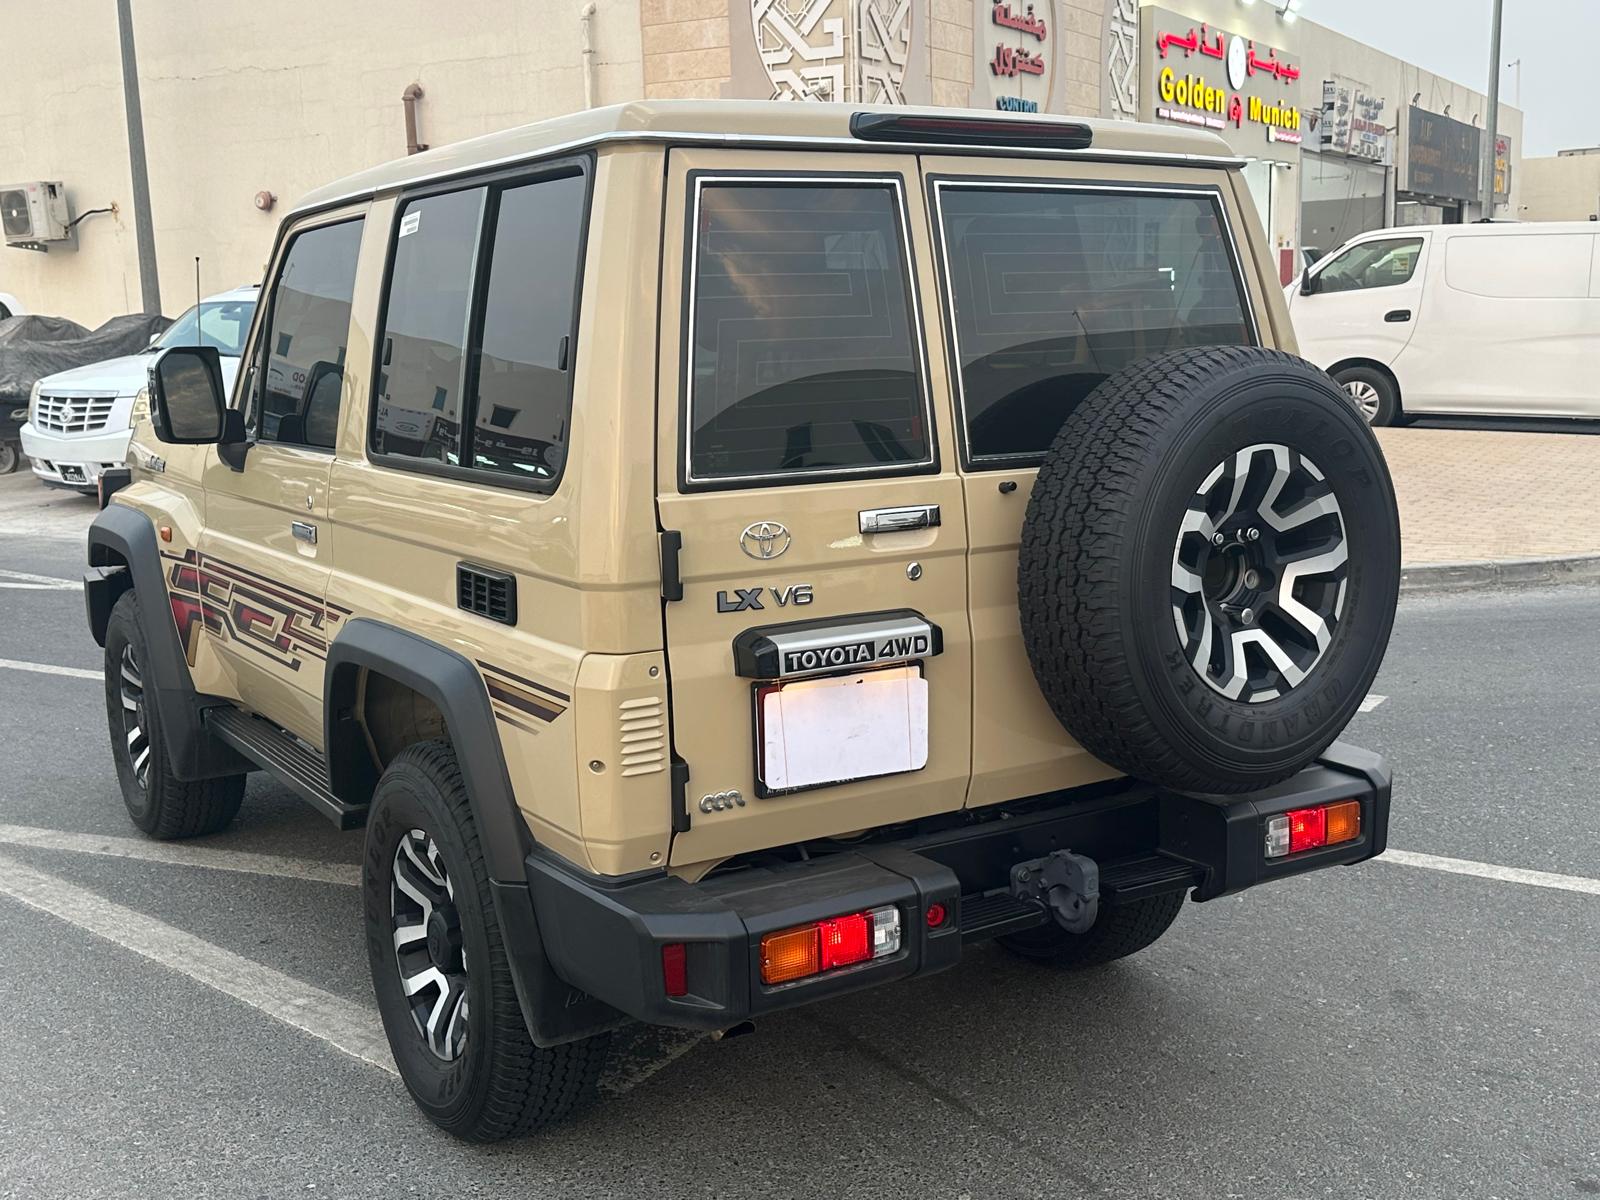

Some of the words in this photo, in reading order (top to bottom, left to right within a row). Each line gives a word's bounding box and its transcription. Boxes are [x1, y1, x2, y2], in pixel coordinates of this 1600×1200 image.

[990, 42, 1045, 77] كنترول
[1159, 66, 1225, 113] Golden
[1249, 95, 1300, 130] Munich
[716, 587, 765, 613] LX
[768, 583, 814, 608] V6
[787, 643, 872, 671] TOYOTA
[878, 635, 929, 659] 4WD
